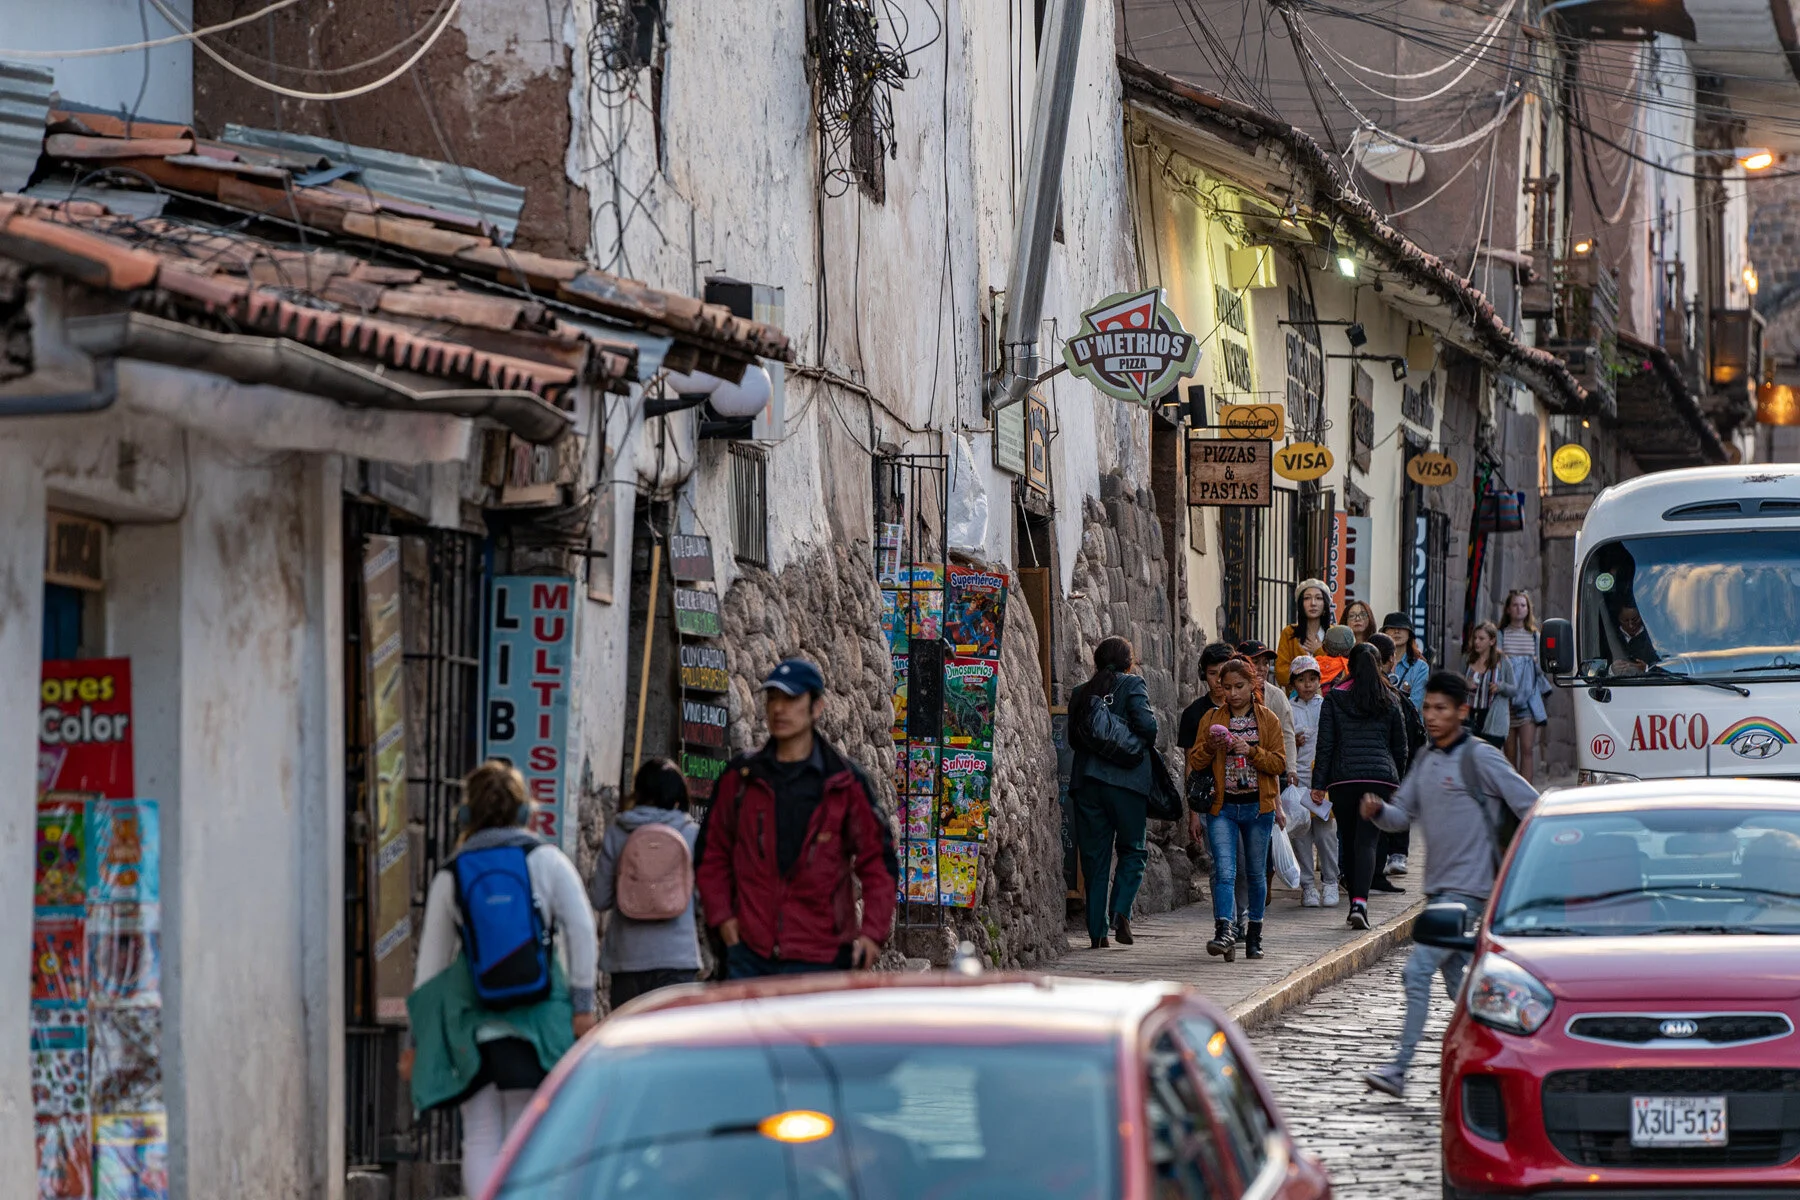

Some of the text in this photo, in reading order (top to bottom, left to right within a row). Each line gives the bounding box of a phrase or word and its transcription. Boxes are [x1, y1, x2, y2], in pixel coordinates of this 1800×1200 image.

[1074, 332, 1185, 361] D'METRIOS
[1119, 358, 1147, 370] PIZZA
[1204, 446, 1256, 464] PIZZAS
[1281, 452, 1327, 470] VISA
[1224, 466, 1235, 480] &
[1414, 460, 1452, 477] VISA
[1200, 482, 1259, 500] PASTAS
[951, 571, 1003, 589] Superhéroes
[945, 660, 993, 679] Dinosaurios
[39, 704, 129, 744] Color
[529, 583, 569, 847] MULTISER
[702, 705, 727, 728] BLANCO
[1628, 712, 1709, 752] ARCO
[1593, 739, 1612, 756] 07
[942, 754, 986, 774] Salvajes
[898, 845, 934, 858] TAZOS
[1637, 1109, 1722, 1135] X3U-513
